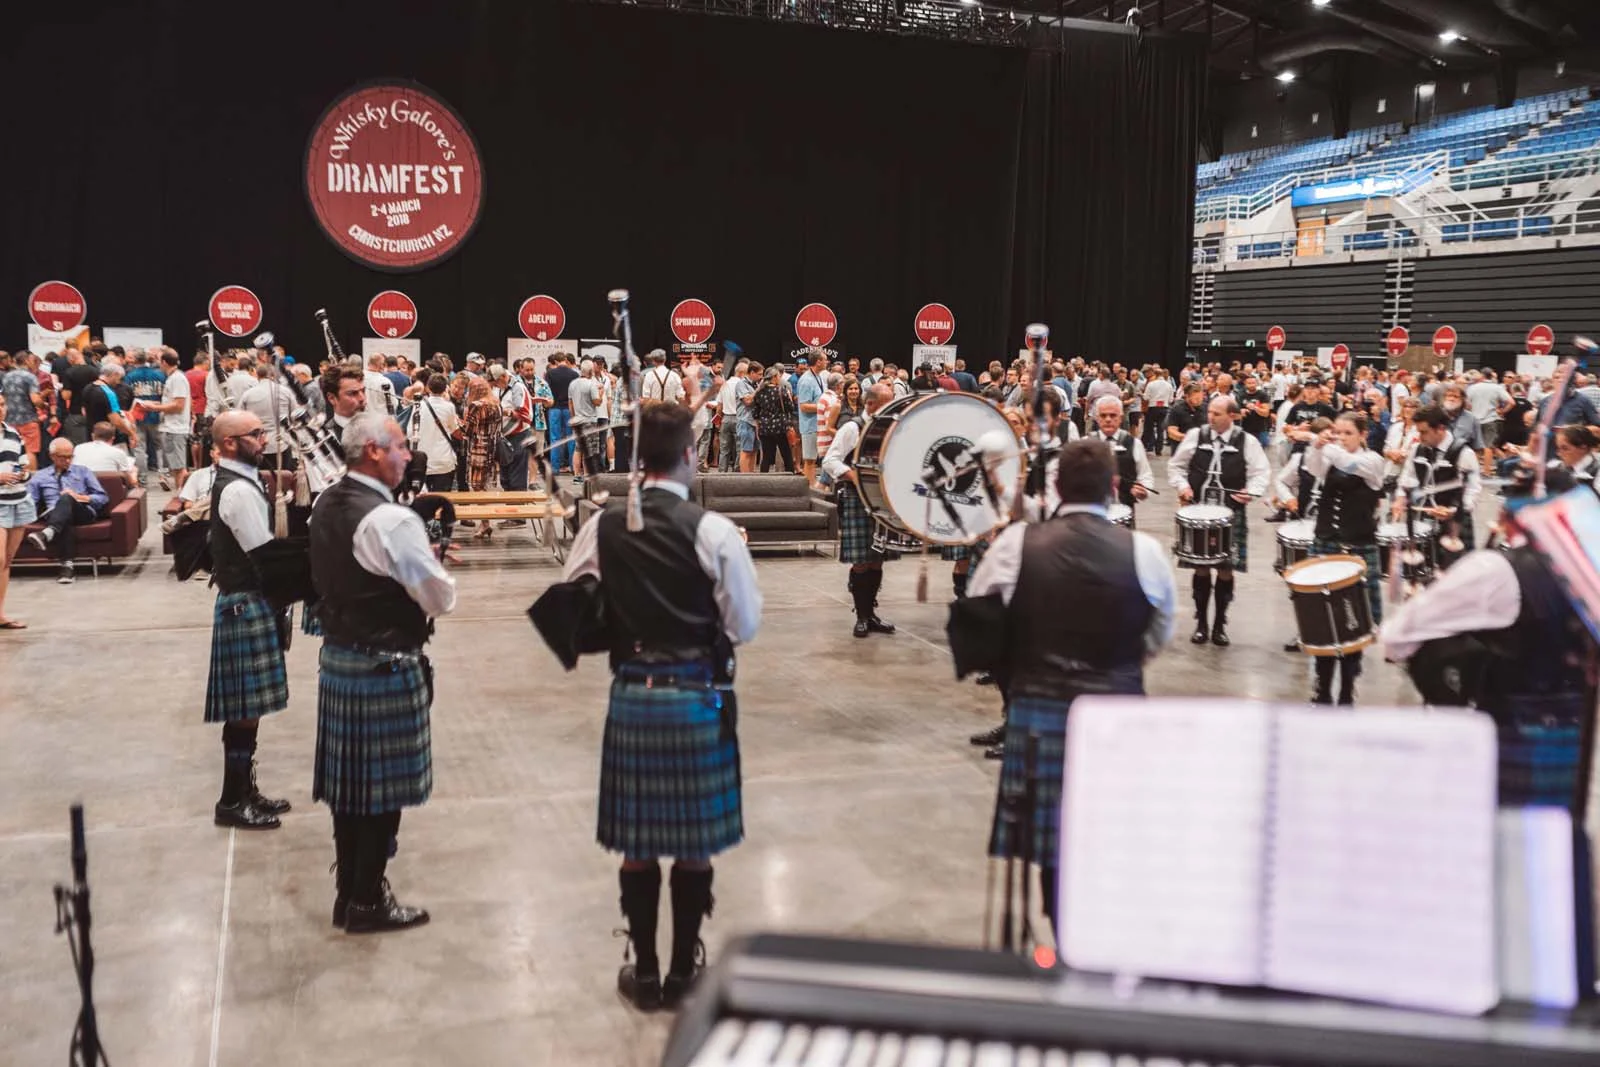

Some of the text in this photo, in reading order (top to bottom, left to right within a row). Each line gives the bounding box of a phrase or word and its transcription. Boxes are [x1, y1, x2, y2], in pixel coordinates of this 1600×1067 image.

[330, 99, 456, 161] Whisky Galore's
[327, 162, 464, 194] DRAMFEST
[370, 199, 421, 217] 2-4 MARCH
[386, 213, 410, 227] 2018
[348, 223, 453, 253] CHRISTCHURCH NZ
[528, 314, 557, 324] ADELPHI
[675, 317, 711, 327] SPRINGBANK
[387, 327, 398, 337] 49
[688, 333, 698, 343] 47
[930, 336, 939, 345] 45
